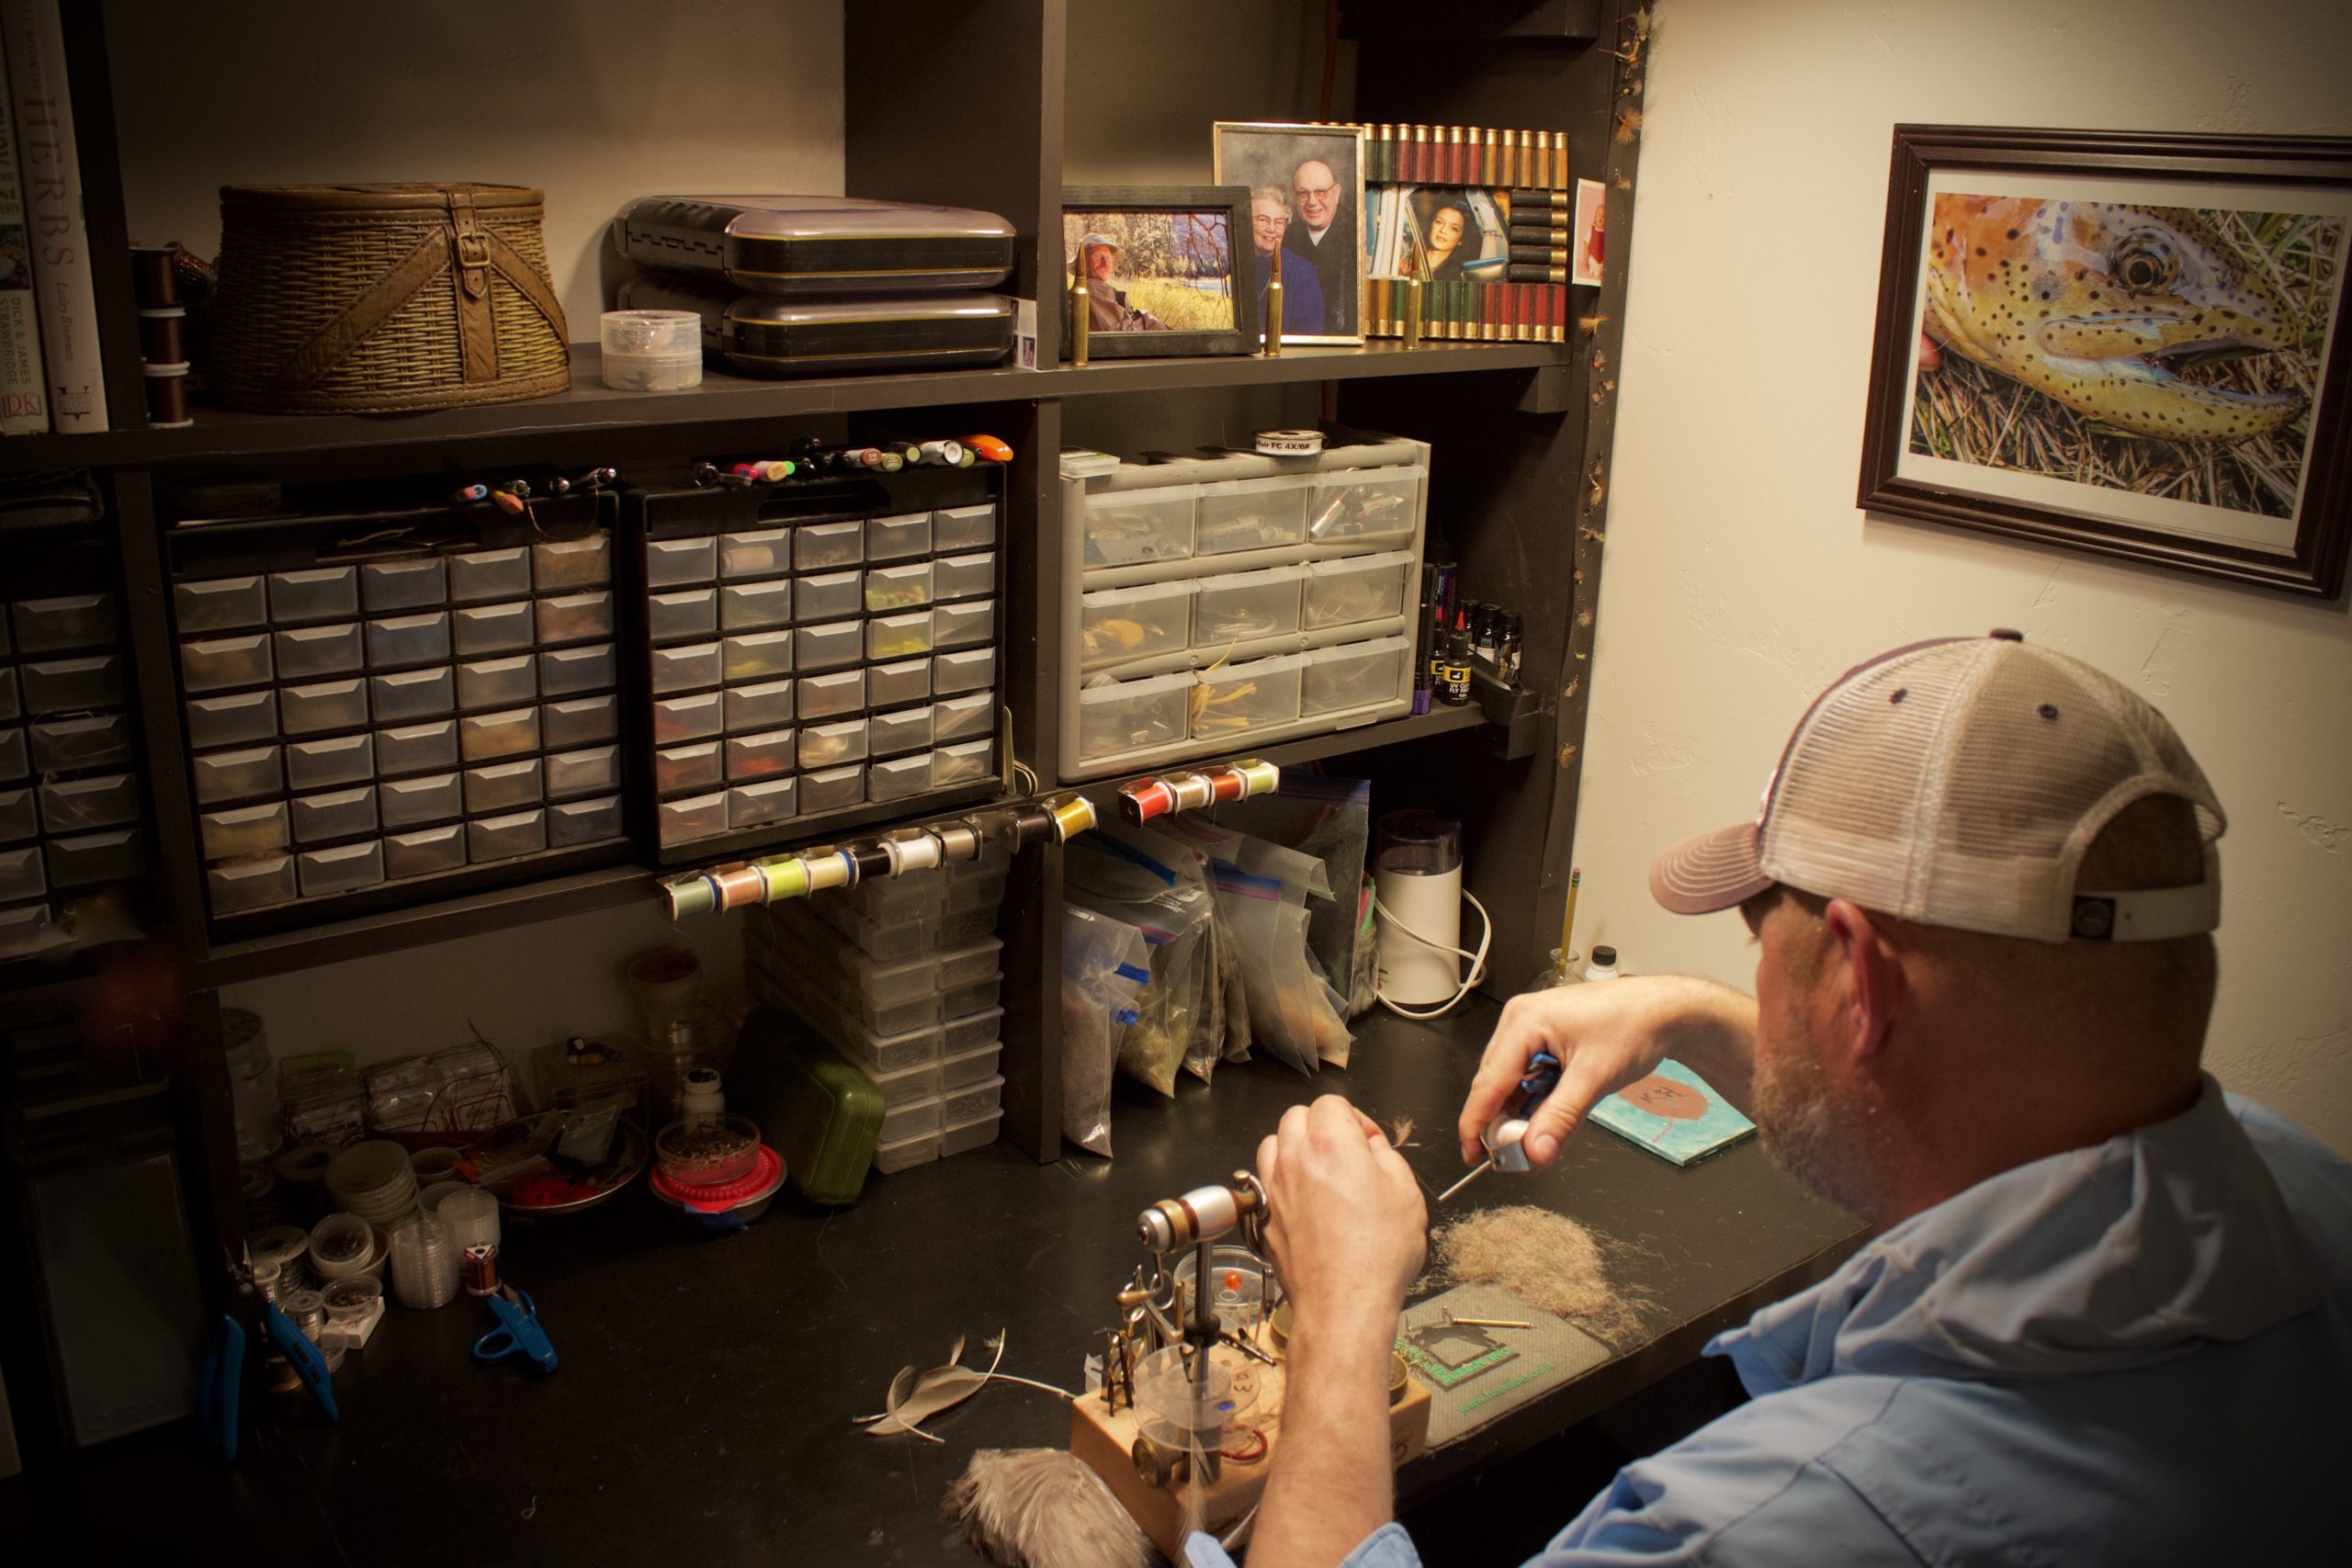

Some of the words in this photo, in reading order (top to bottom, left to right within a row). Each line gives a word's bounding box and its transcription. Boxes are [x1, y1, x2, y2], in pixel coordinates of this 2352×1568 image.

[23, 96, 74, 265] HERBS
[0, 298, 18, 385] STRAWBRIDGE
[10, 298, 24, 327] DICK
[17, 344, 31, 384] JAMES
[6, 395, 37, 413] DK
